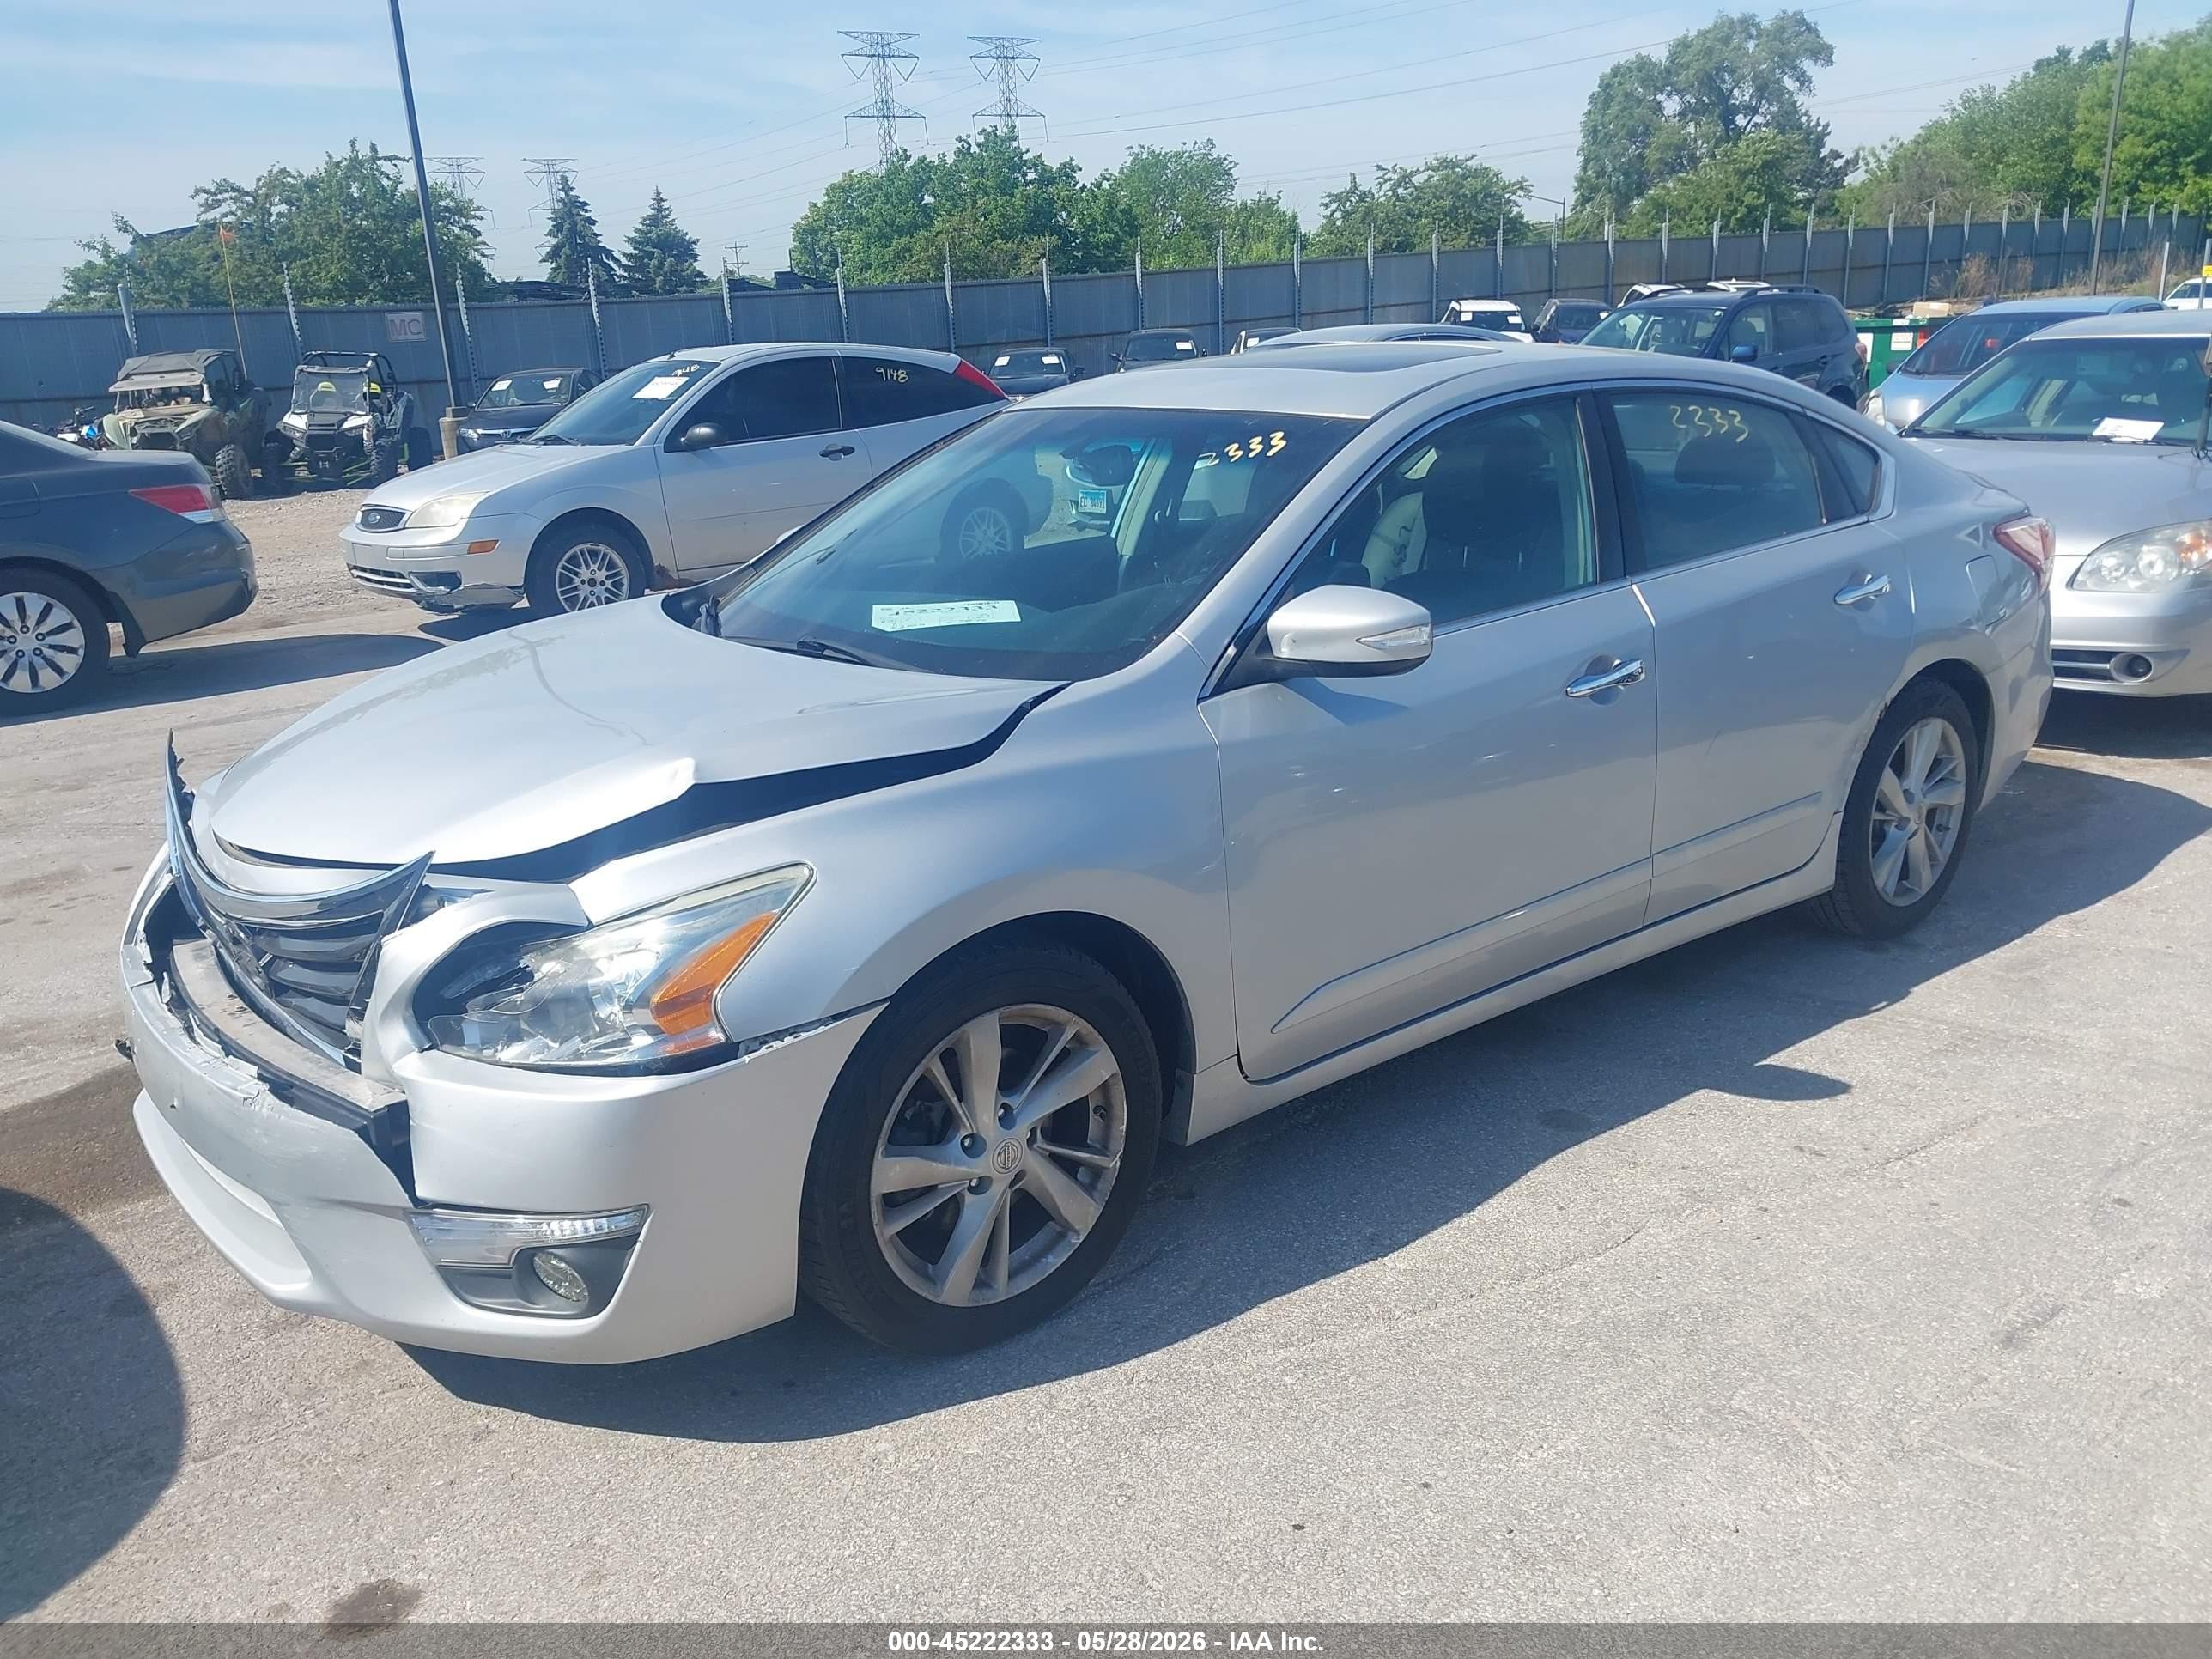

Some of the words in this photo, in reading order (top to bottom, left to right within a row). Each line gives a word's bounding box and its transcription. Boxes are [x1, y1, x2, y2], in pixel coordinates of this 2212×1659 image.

[389, 319, 422, 336] MC
[875, 367, 908, 383] 9148
[1670, 405, 1749, 443] 2333
[1198, 431, 1287, 466] 2333
